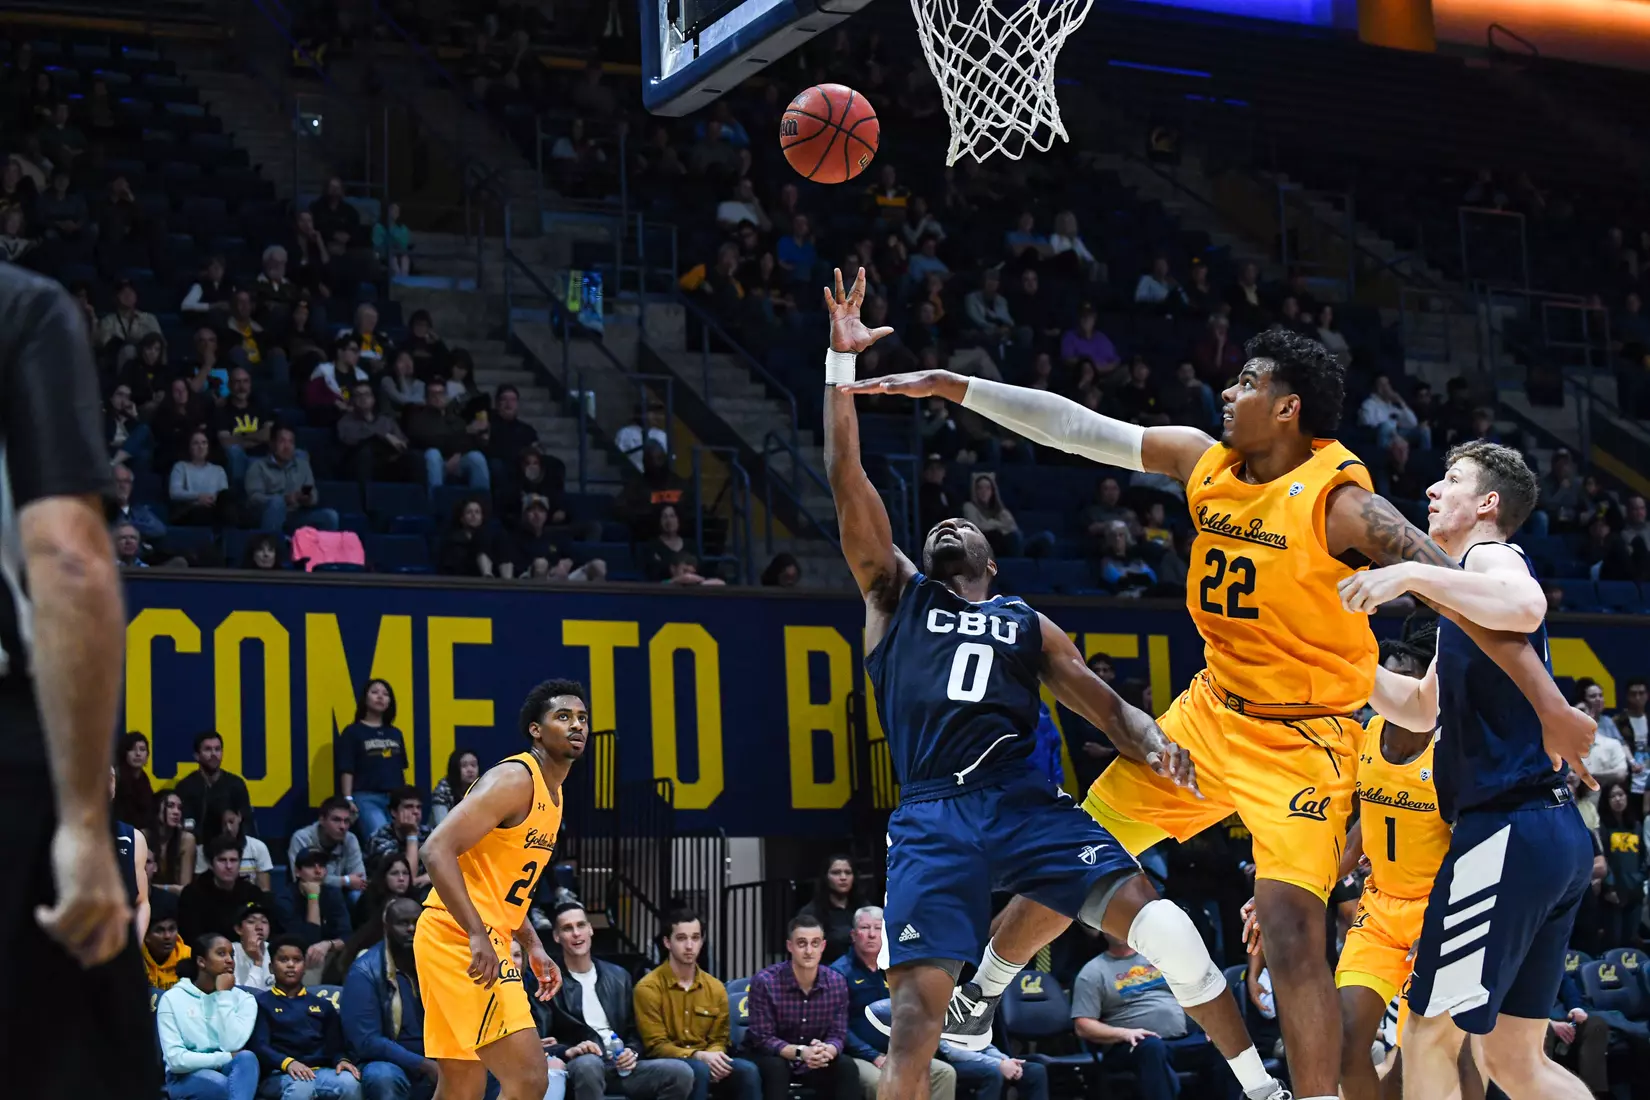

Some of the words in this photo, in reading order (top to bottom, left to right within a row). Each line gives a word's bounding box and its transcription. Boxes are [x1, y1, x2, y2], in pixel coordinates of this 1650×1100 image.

[1244, 518, 1287, 546] Bears
[1200, 548, 1259, 619] 22
[926, 607, 1018, 645] CBU
[947, 642, 994, 703] 0
[562, 619, 724, 809] TO
[1287, 786, 1331, 821] Cal
[1394, 791, 1436, 811] Bears
[1385, 816, 1396, 862] 1
[1021, 974, 1044, 995] Cal
[1599, 963, 1619, 982] Cal
